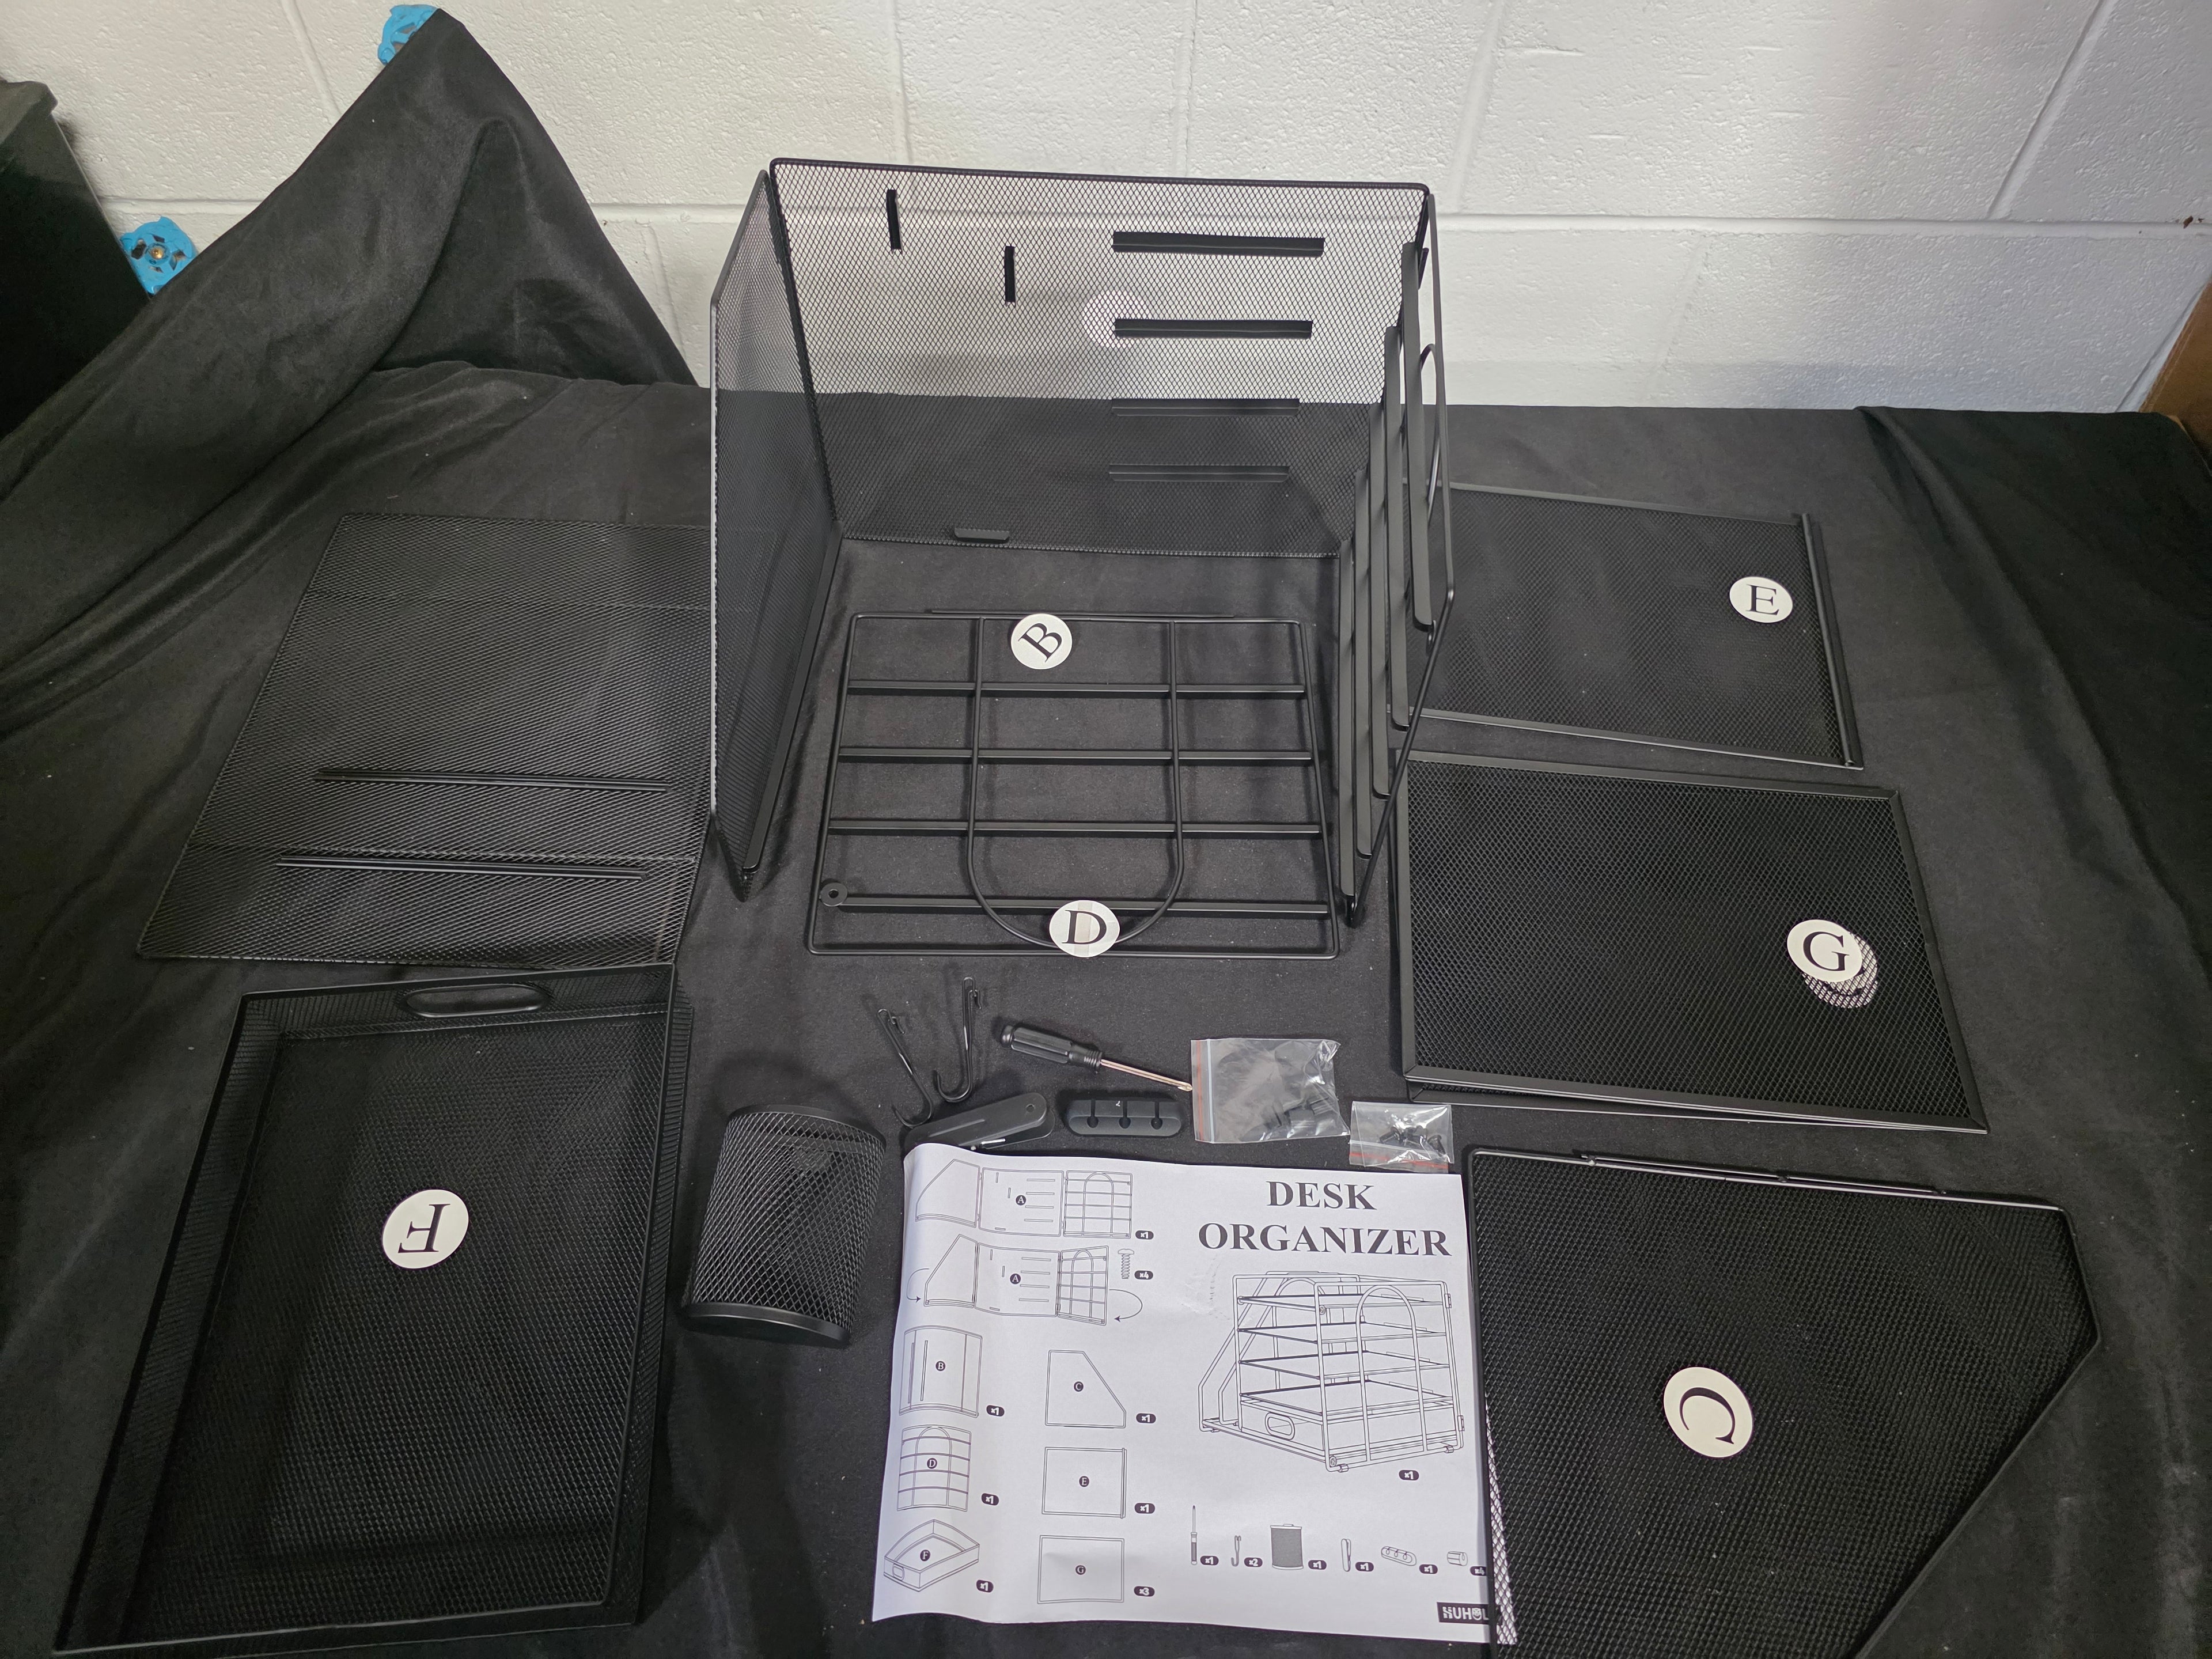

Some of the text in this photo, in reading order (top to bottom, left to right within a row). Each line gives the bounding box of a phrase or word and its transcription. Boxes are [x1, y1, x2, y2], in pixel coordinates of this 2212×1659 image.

[1745, 584, 1779, 616] E
[1017, 623, 1062, 662] B
[1061, 909, 1107, 945] D
[1802, 931, 1850, 972] G
[1017, 1196, 1025, 1204] A
[1266, 1181, 1377, 1210] DESK
[397, 1203, 450, 1253] F
[1199, 1222, 1452, 1256] ORGANIZER
[1012, 1274, 1019, 1282] A
[937, 1362, 944, 1370] B
[1075, 1382, 1082, 1391] C
[1679, 1387, 1735, 1445] C
[929, 1459, 936, 1468] D
[1081, 1477, 1087, 1486] E
[922, 1551, 929, 1560] F
